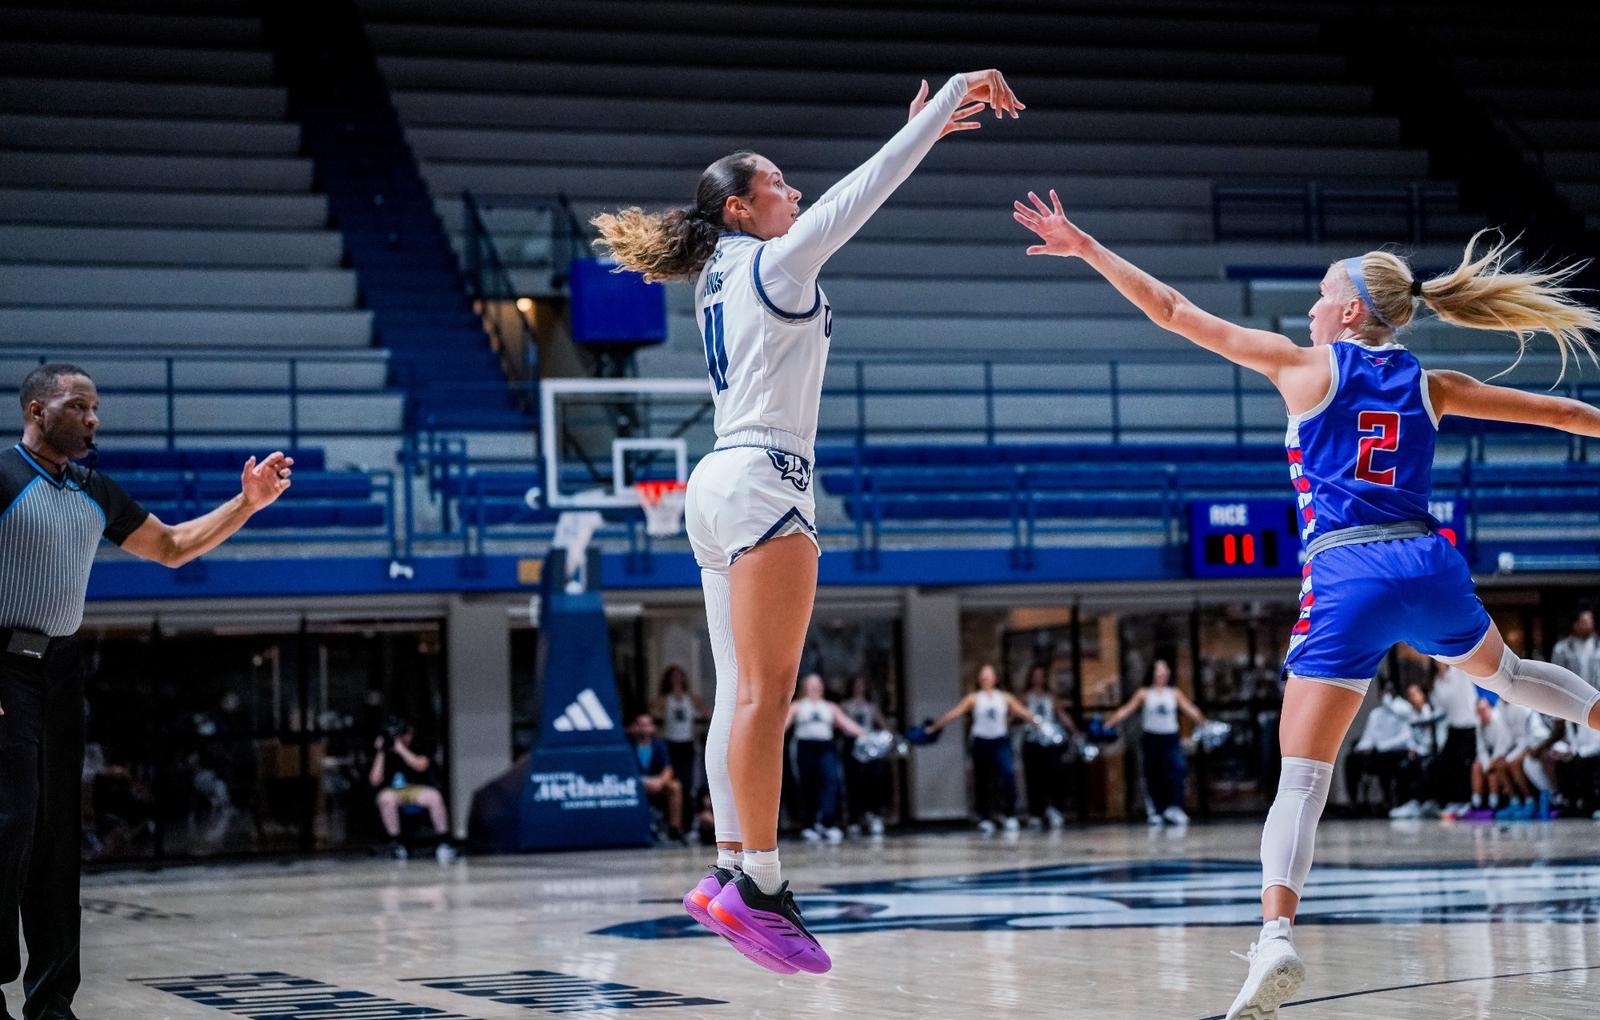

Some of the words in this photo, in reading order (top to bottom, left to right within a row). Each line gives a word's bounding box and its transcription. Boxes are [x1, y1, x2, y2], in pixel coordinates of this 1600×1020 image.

[703, 301, 729, 395] 11
[1354, 410, 1401, 487] 2
[1209, 503, 1248, 526] RICE
[1223, 533, 1255, 565] 11
